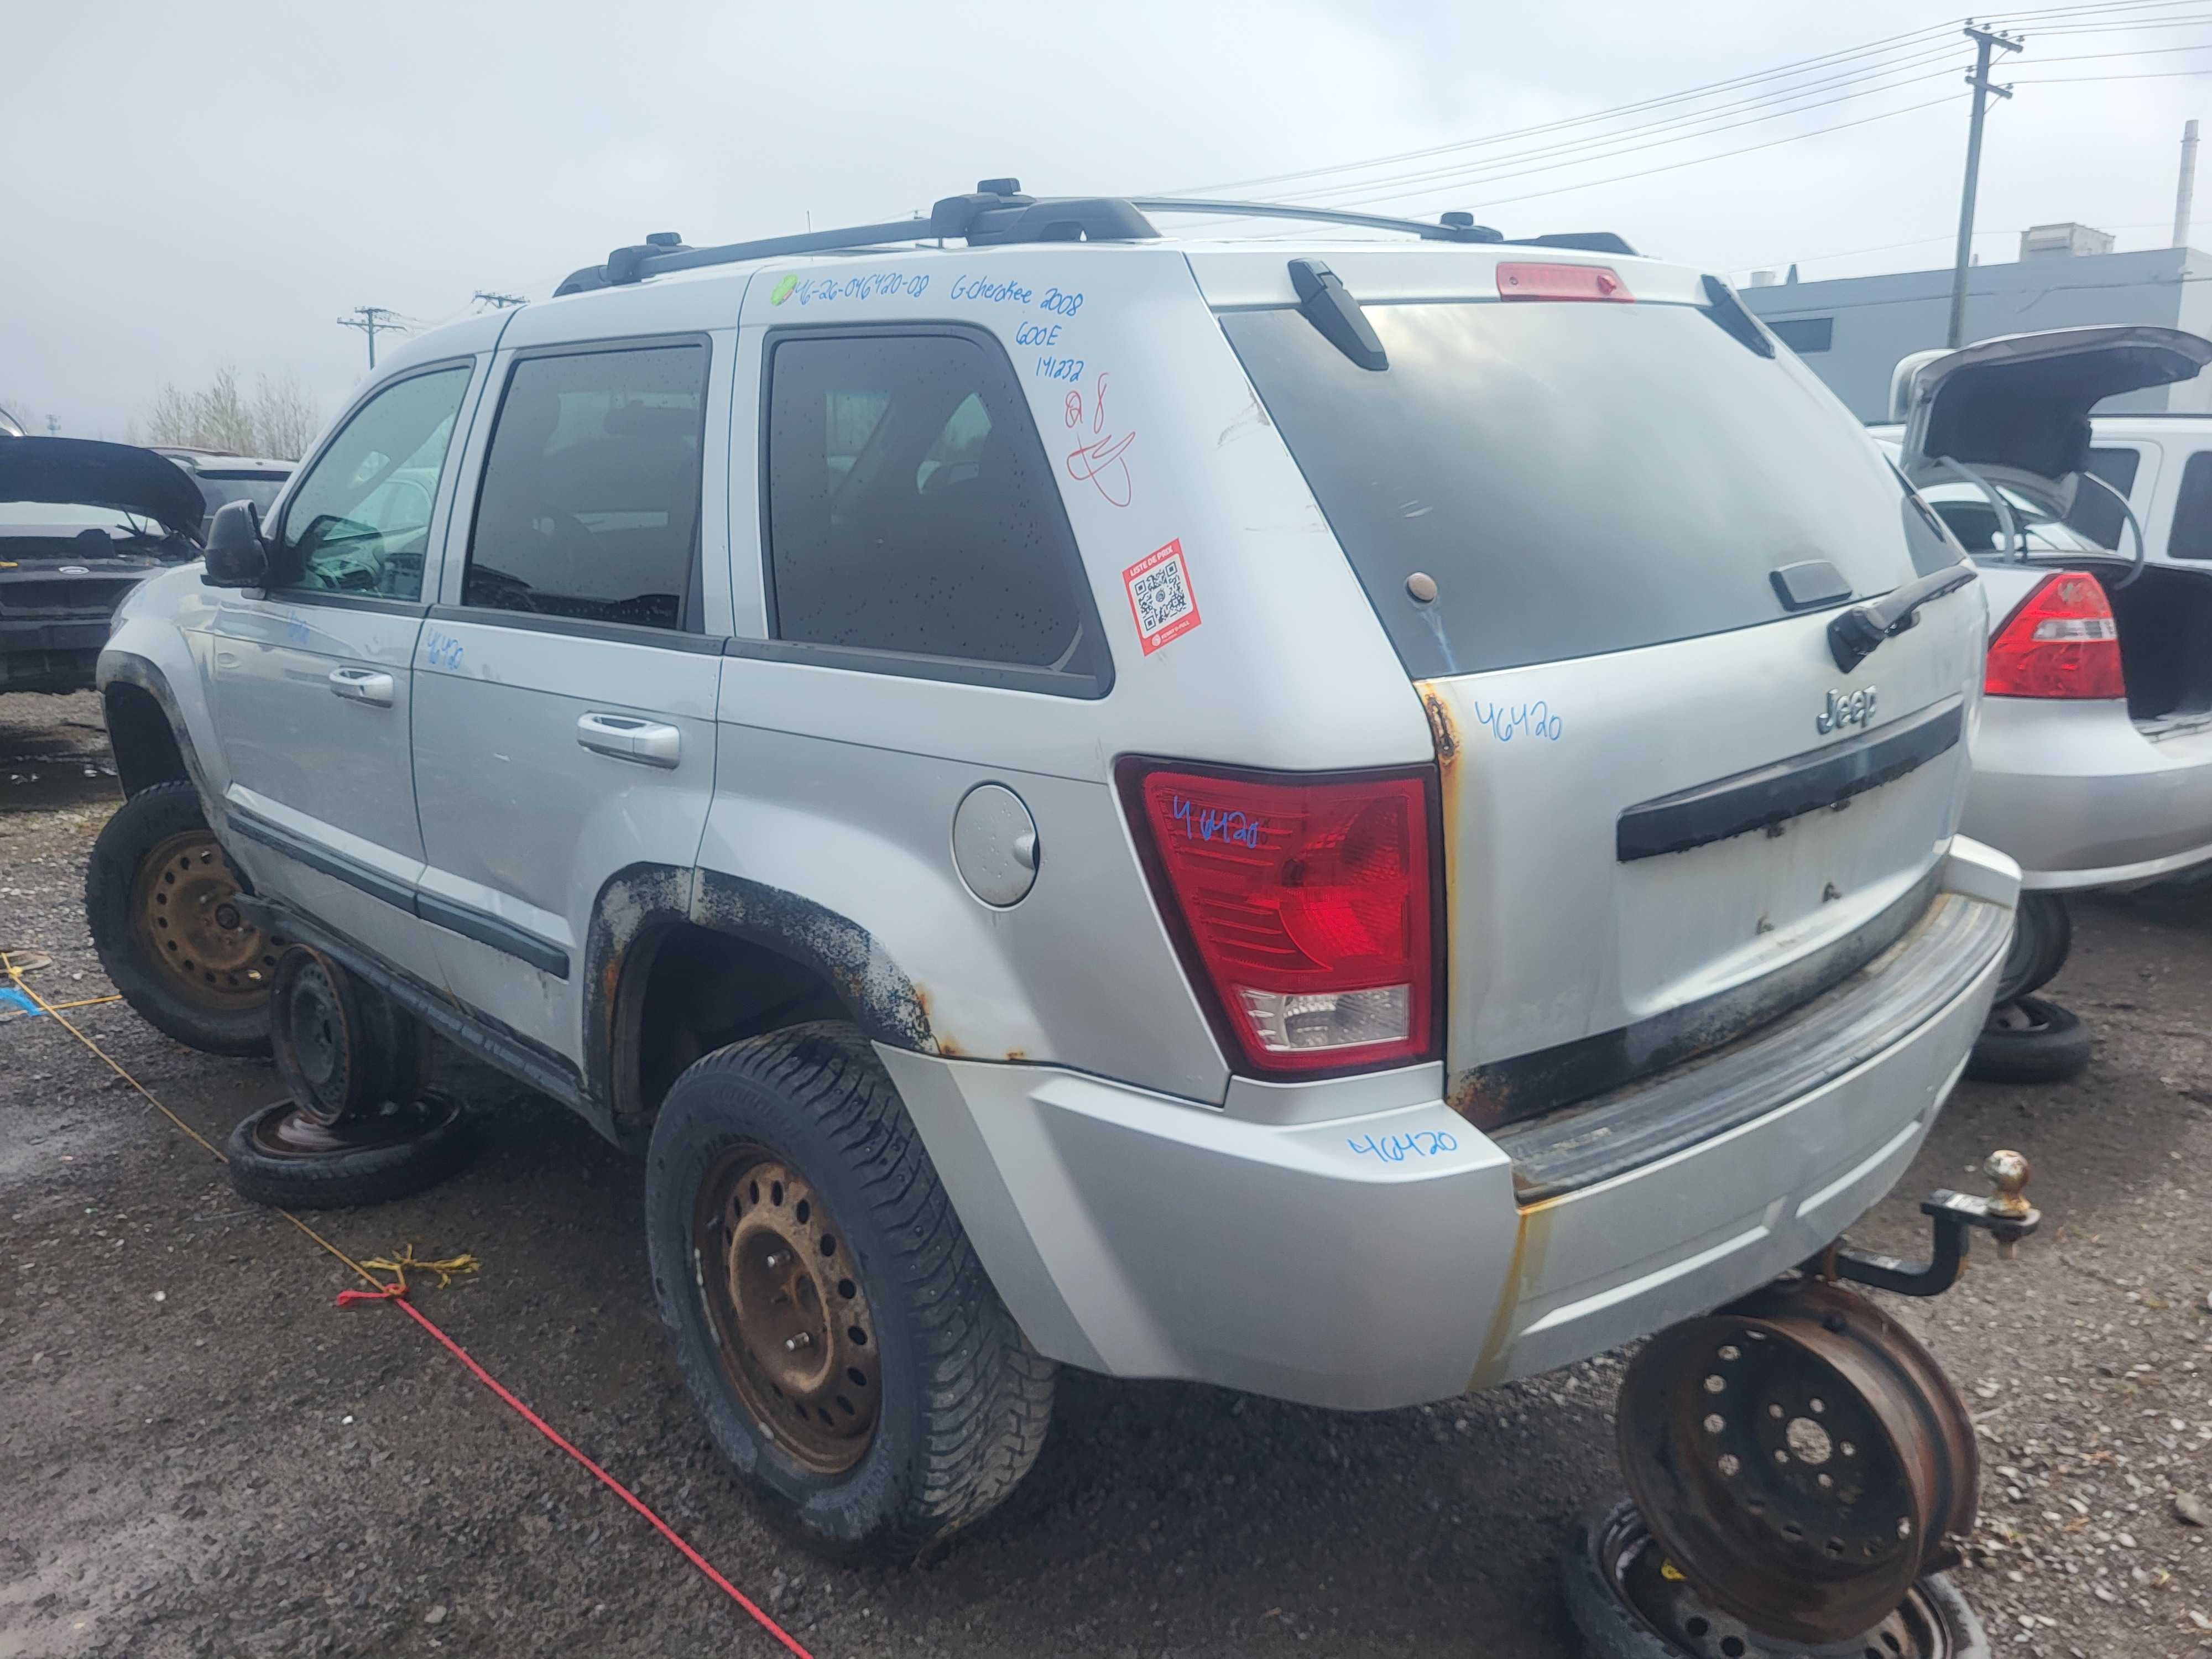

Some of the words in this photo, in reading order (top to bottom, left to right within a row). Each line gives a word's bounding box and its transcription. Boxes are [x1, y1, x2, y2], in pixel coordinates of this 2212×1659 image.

[1040, 288, 1084, 317] 2008
[1036, 356, 1085, 383] 141232
[1130, 560, 1148, 577] LISTE
[1147, 554, 1158, 566] DE
[1157, 545, 1173, 560] PRIX
[1474, 701, 1562, 742] 46420
[1815, 685, 1877, 735] Jeep
[1173, 795, 1260, 849] 46420
[1347, 1131, 1457, 1163] 46420
